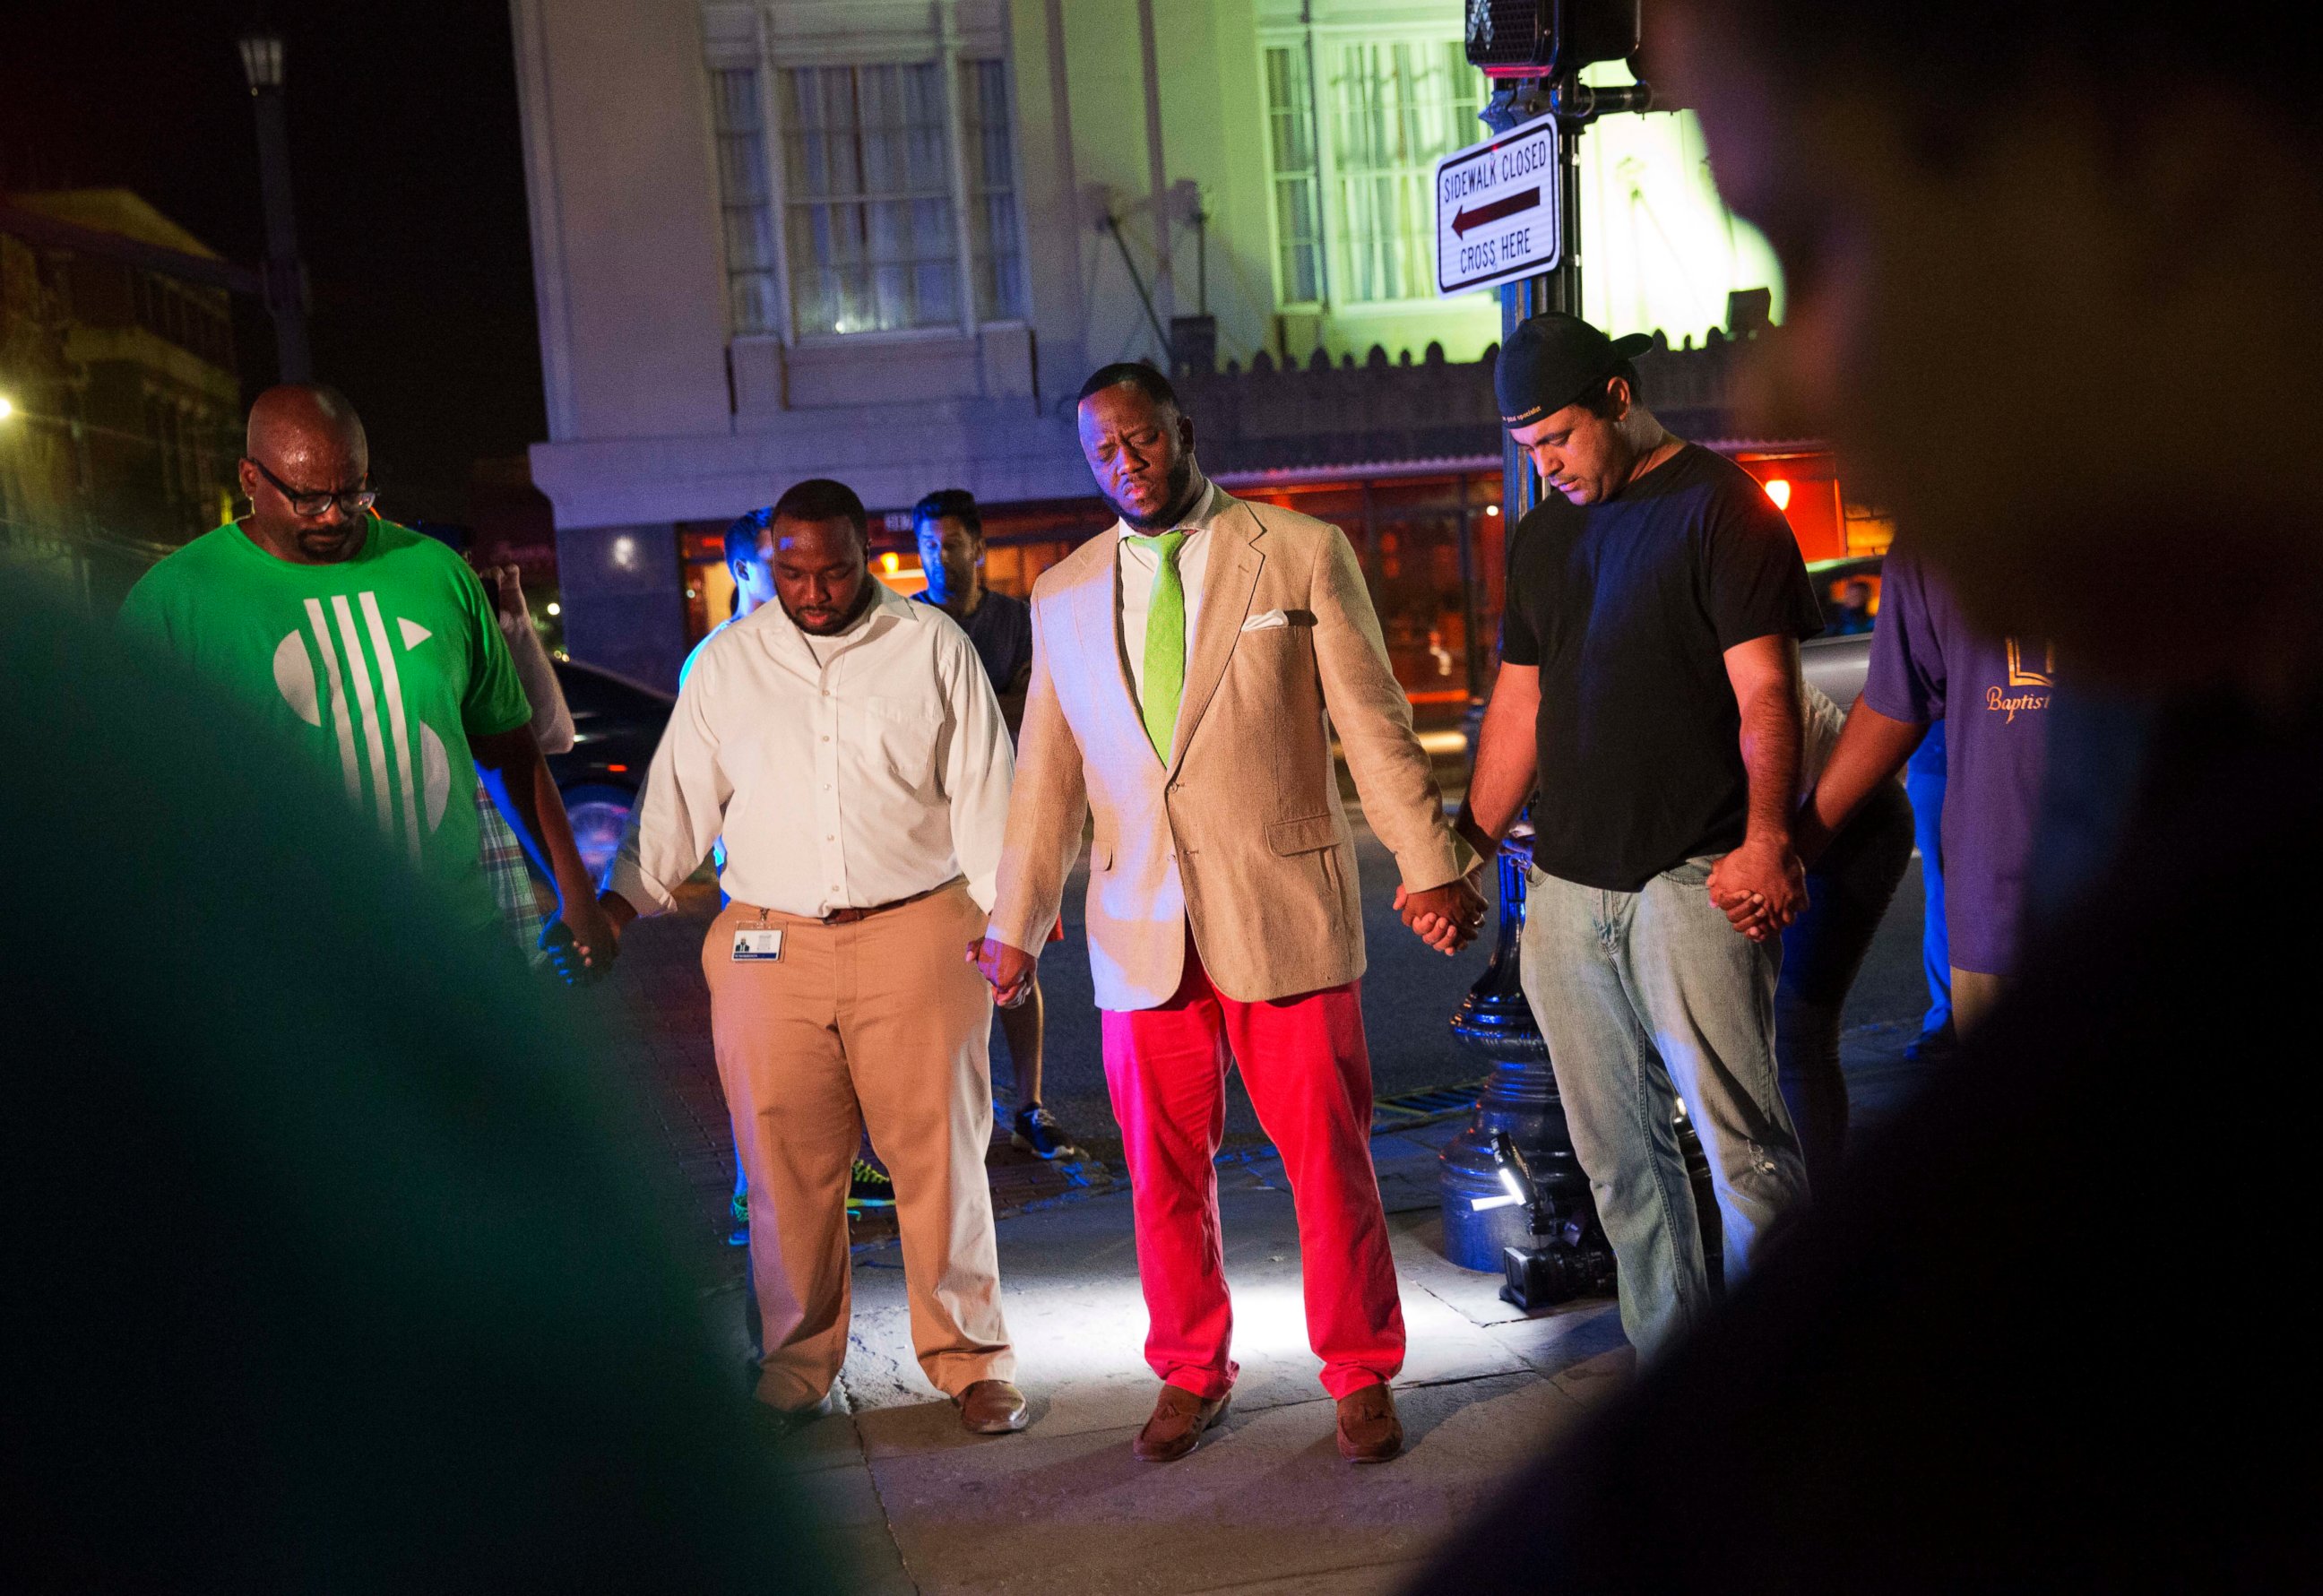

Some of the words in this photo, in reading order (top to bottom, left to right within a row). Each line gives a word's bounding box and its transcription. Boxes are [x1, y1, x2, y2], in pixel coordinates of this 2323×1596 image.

[1444, 159, 1497, 203] SIDEWALK
[1502, 140, 1547, 182] CLOSED
[1460, 239, 1496, 274] CROSS
[1501, 228, 1532, 262] HERE
